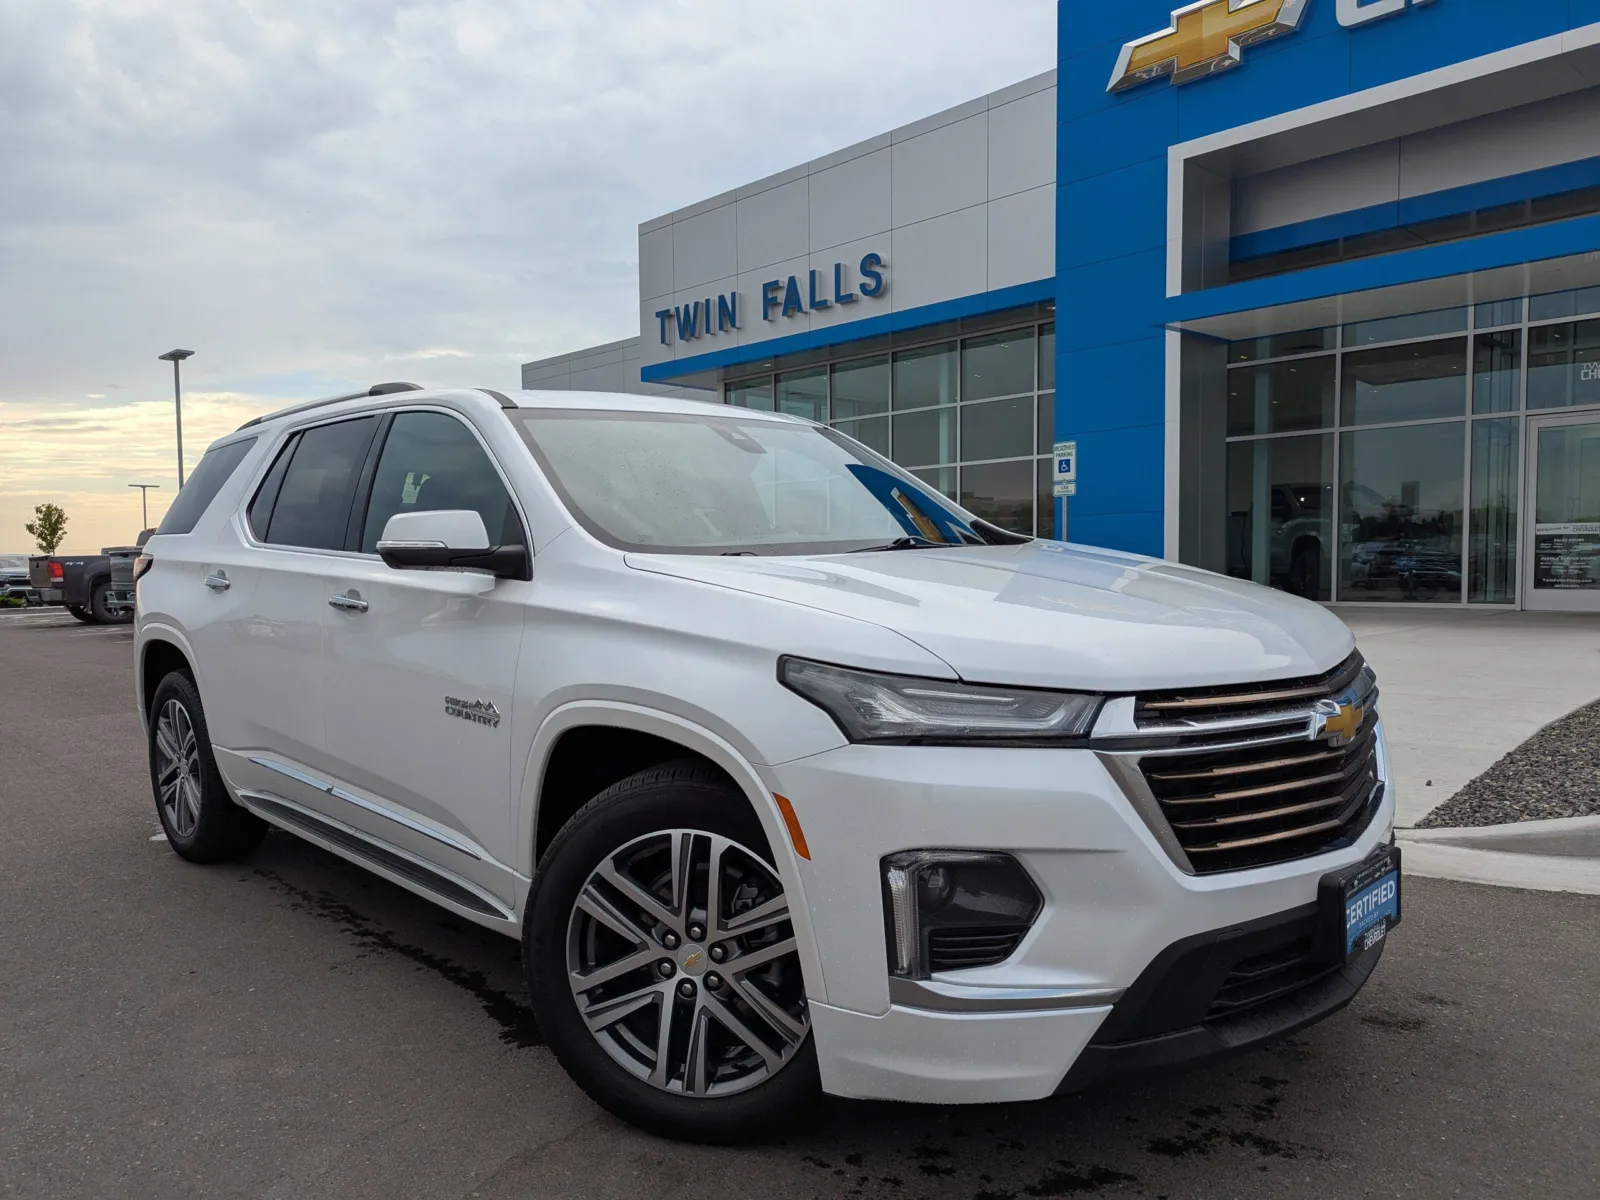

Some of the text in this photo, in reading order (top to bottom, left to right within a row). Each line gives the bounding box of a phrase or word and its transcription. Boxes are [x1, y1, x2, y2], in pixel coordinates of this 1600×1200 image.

[655, 252, 887, 346] TWIN FALLS
[444, 706, 501, 729] COUNTRY
[1363, 926, 1387, 951] CHEVROLET
